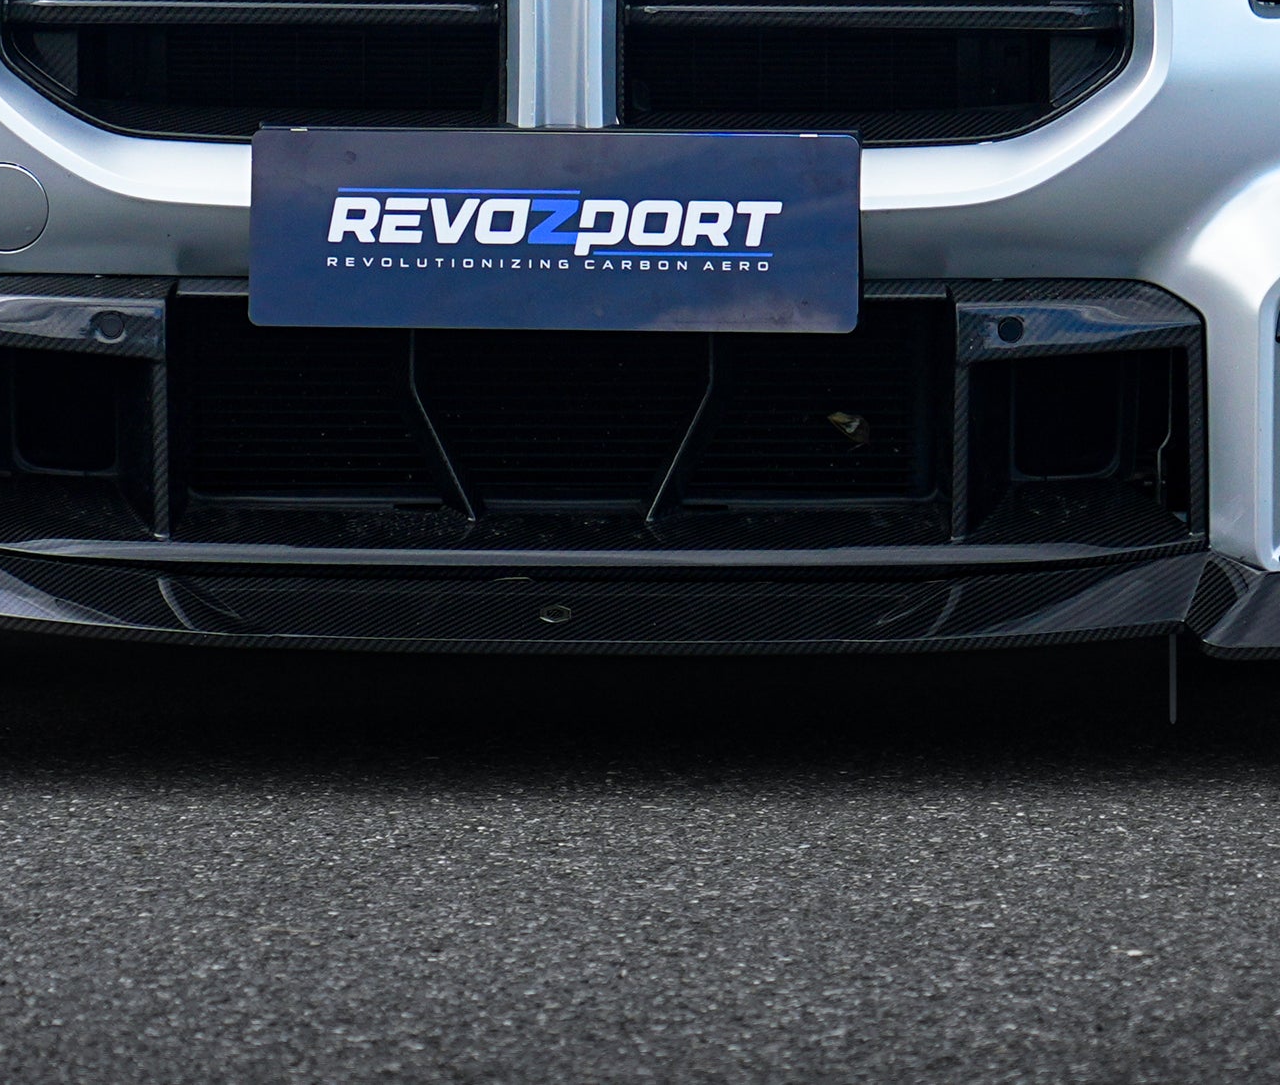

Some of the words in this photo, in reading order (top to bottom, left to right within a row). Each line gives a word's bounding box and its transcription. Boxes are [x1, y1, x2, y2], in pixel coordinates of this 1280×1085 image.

[327, 197, 783, 256] REVOZPORT
[326, 257, 570, 270] REVOLUTIONIZING
[584, 259, 689, 271] CARBON
[703, 260, 770, 271] AERO
